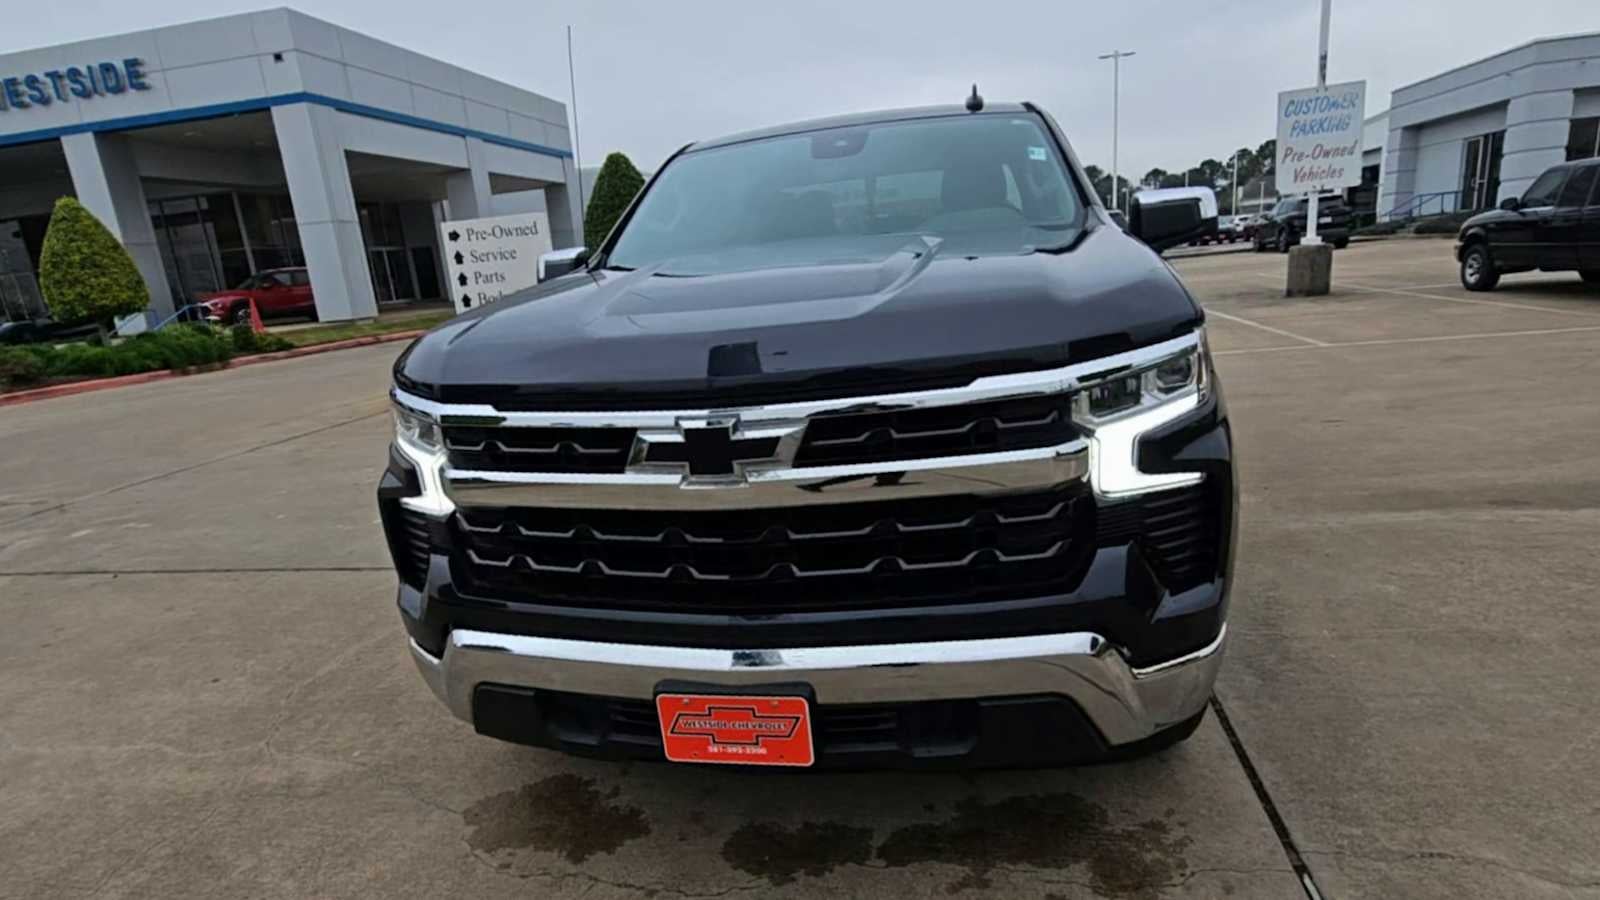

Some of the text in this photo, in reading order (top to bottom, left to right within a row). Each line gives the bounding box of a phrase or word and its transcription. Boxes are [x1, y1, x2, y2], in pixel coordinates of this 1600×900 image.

[1284, 92, 1359, 118] CUSTOMER
[1289, 114, 1352, 138] PARKING
[1281, 139, 1358, 164] Pre-Owned
[1293, 164, 1345, 183] Vehicles
[466, 220, 539, 242] Pre-Owned
[470, 248, 517, 264] Service
[474, 270, 506, 285] Parts
